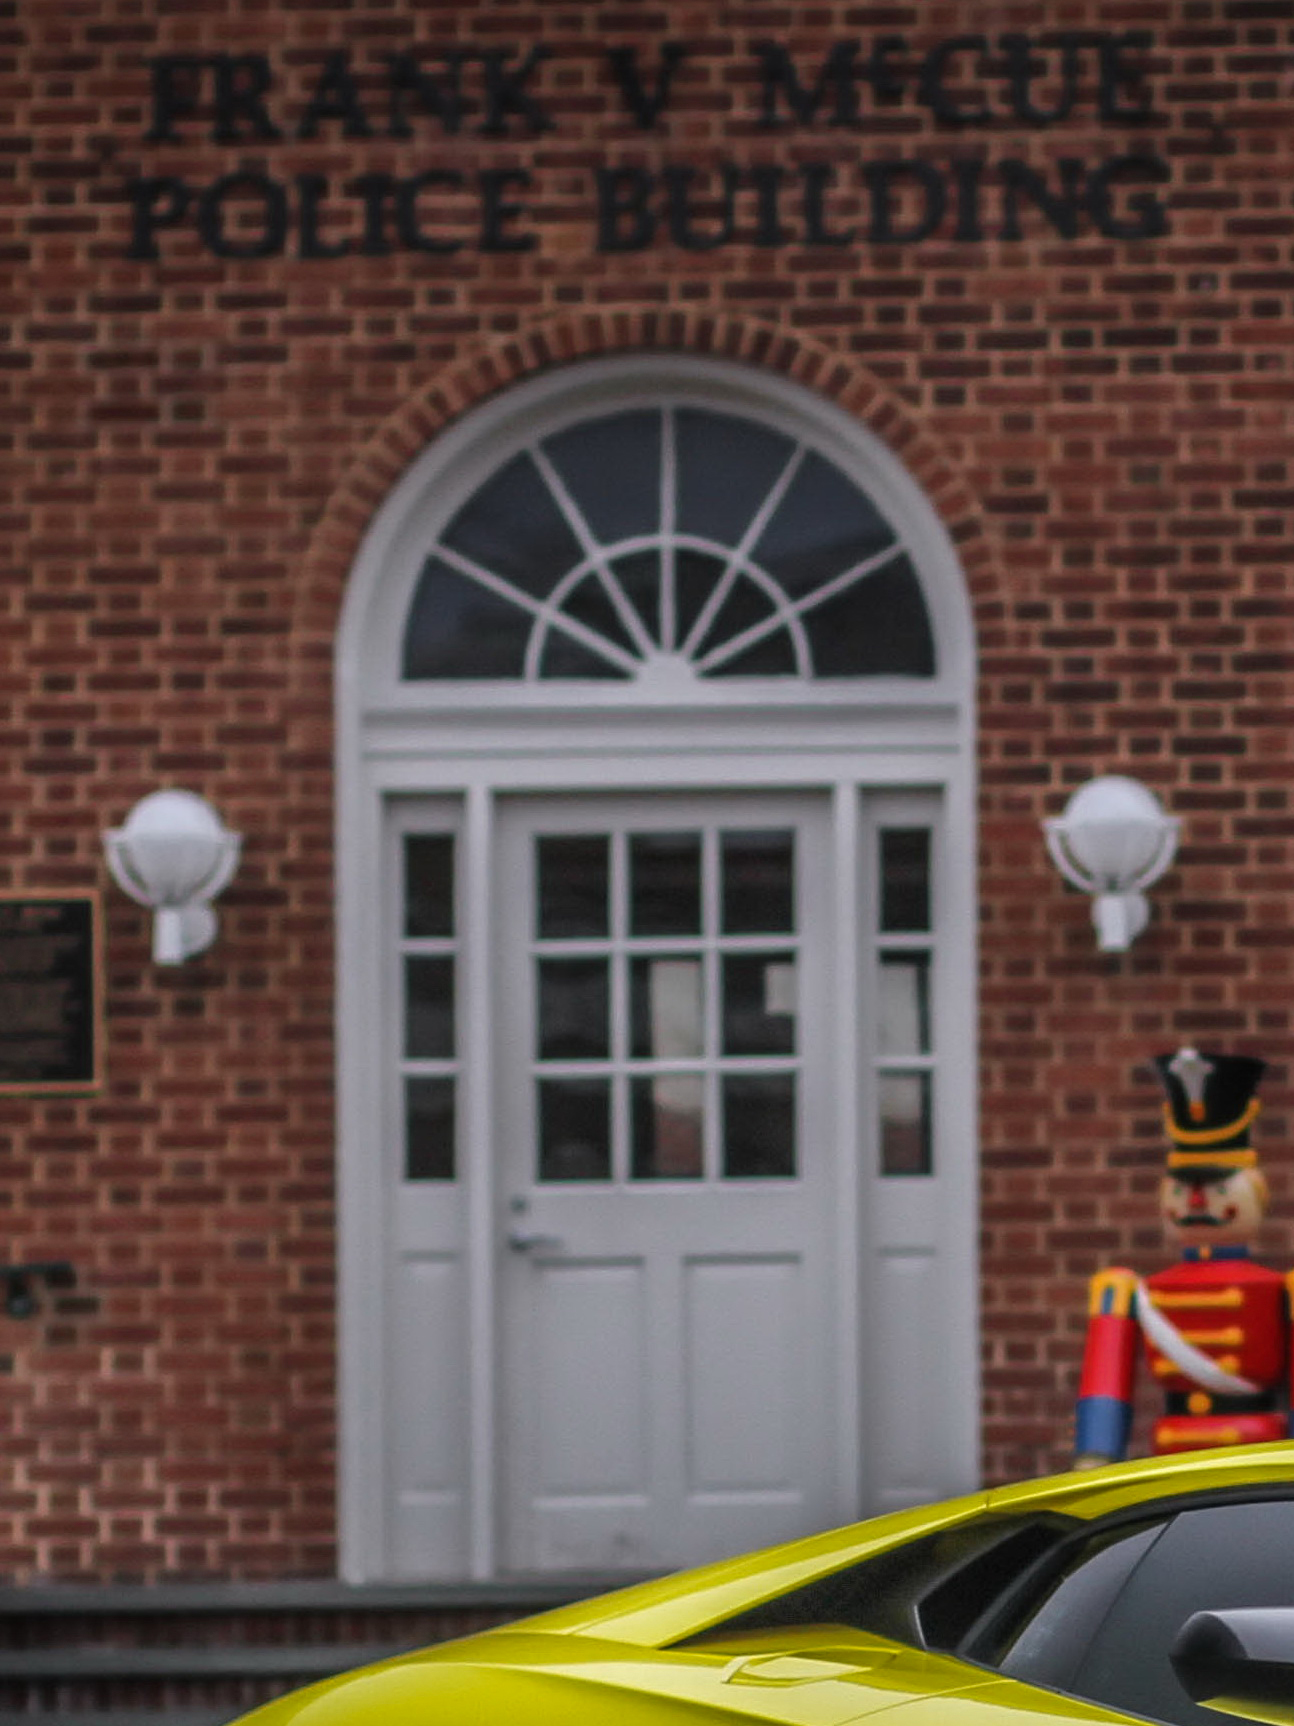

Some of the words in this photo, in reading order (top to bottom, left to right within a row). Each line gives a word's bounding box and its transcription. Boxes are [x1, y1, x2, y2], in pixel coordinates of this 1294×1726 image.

[142, 44, 556, 142] FRANK
[603, 43, 689, 130] V
[127, 171, 538, 260] POLICE
[595, 153, 1174, 254] BUILDING
